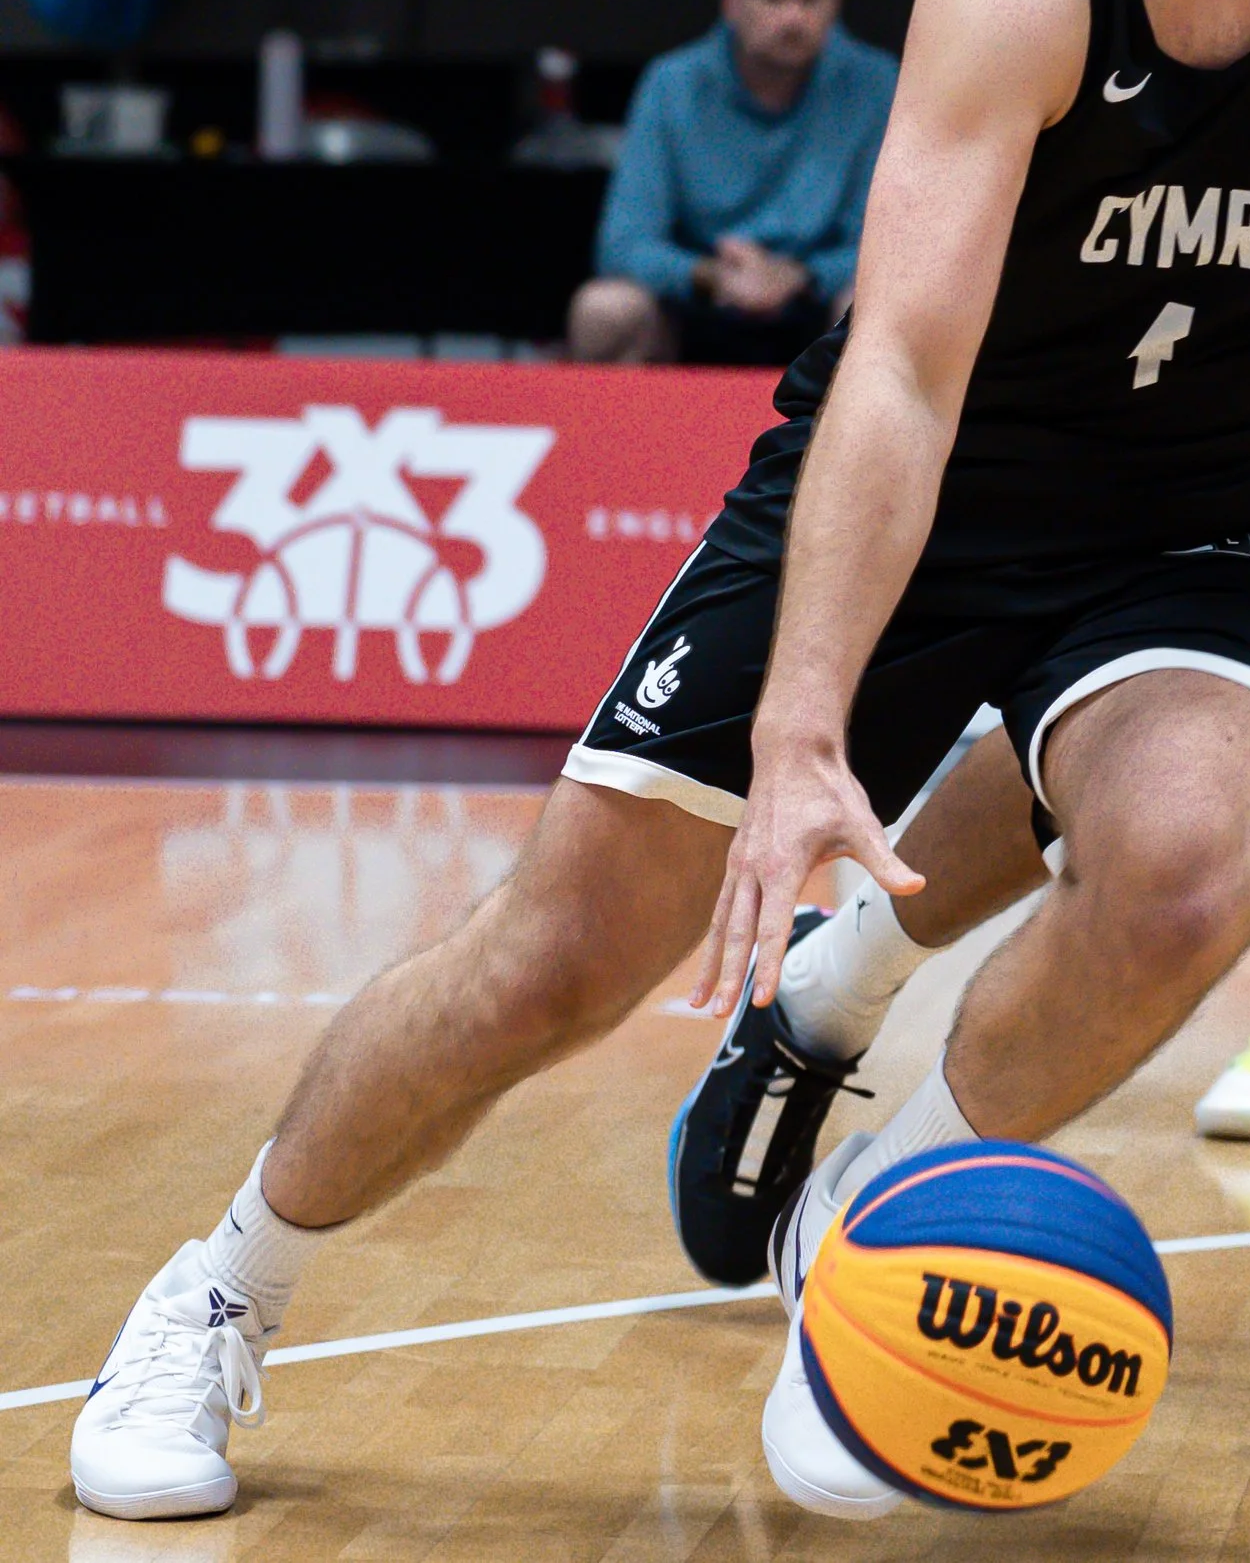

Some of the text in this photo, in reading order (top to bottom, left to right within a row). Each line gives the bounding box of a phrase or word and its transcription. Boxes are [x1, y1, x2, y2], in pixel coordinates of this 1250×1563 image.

[586, 504, 720, 544] ENGL
[614, 711, 646, 736] LOTTERY
[623, 706, 661, 736] NATIONAL
[916, 1271, 1142, 1397] Wilson
